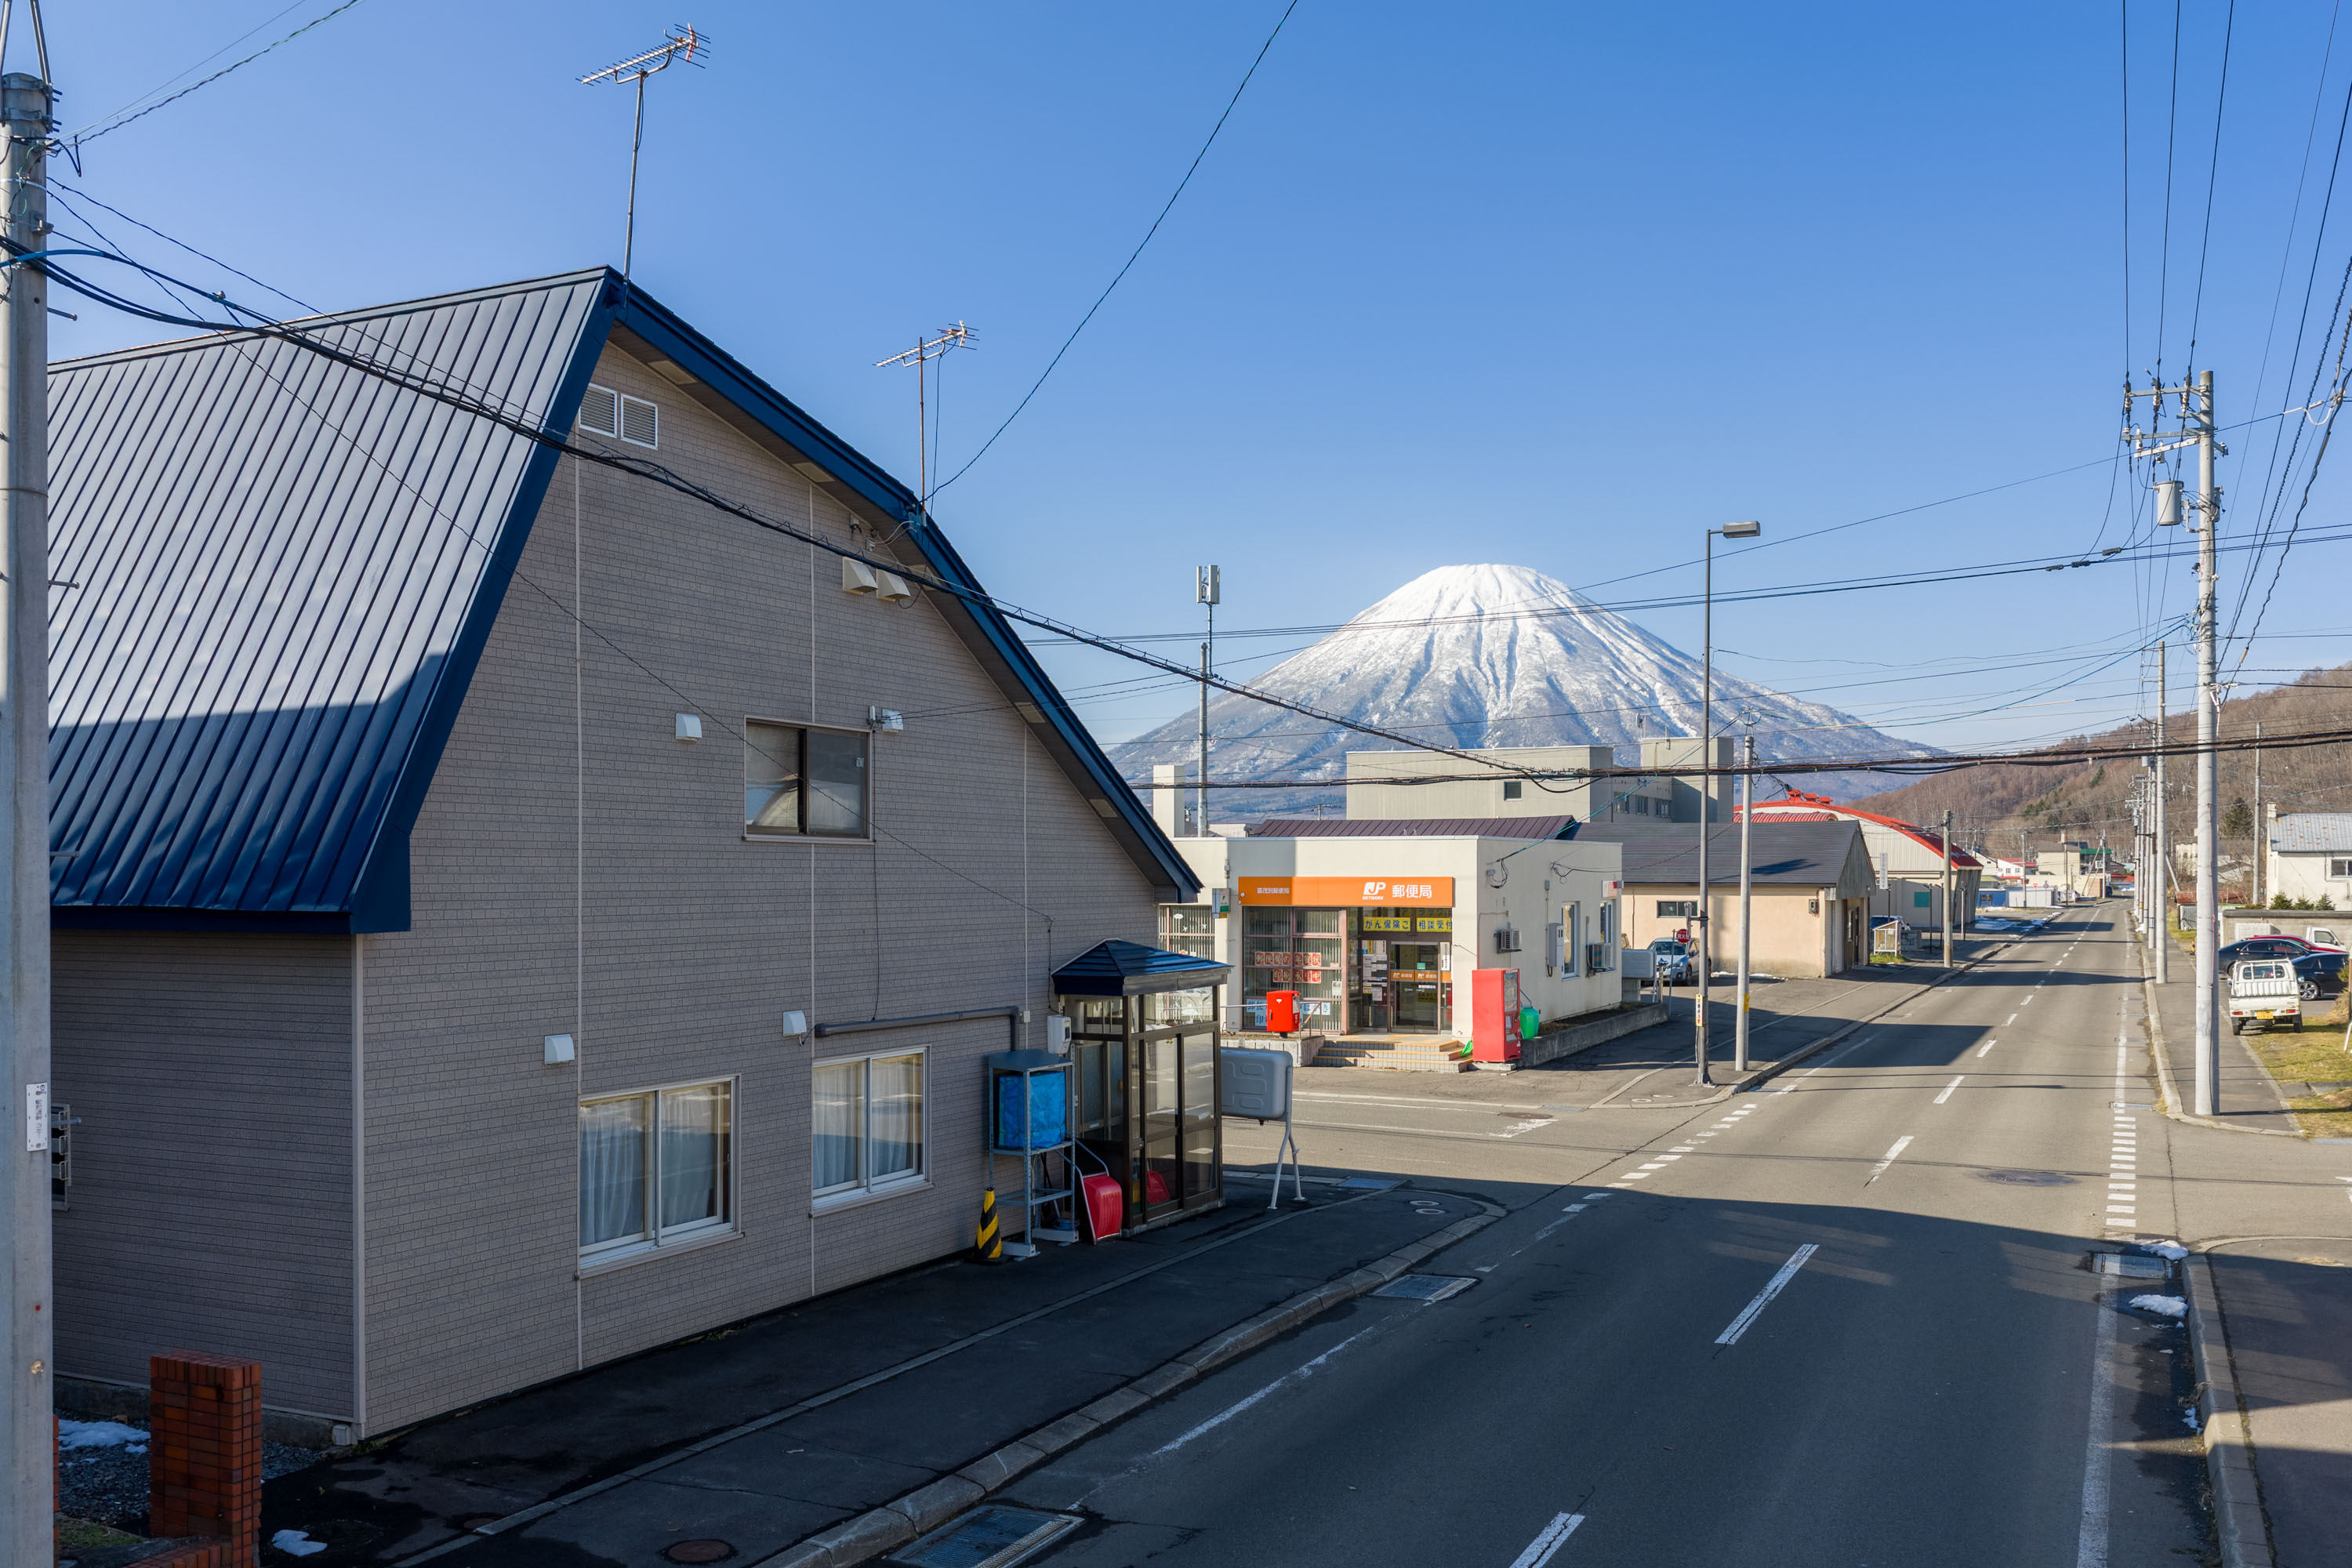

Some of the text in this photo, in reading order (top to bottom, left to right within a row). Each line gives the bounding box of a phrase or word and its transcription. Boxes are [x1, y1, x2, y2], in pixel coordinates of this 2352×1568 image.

[1392, 884, 1432, 898] 郵便局
[1365, 920, 1409, 929] がん保険ご
[1256, 953, 1321, 965] 郵便局の年賀状
[1274, 970, 1320, 981] 印刷承り中
